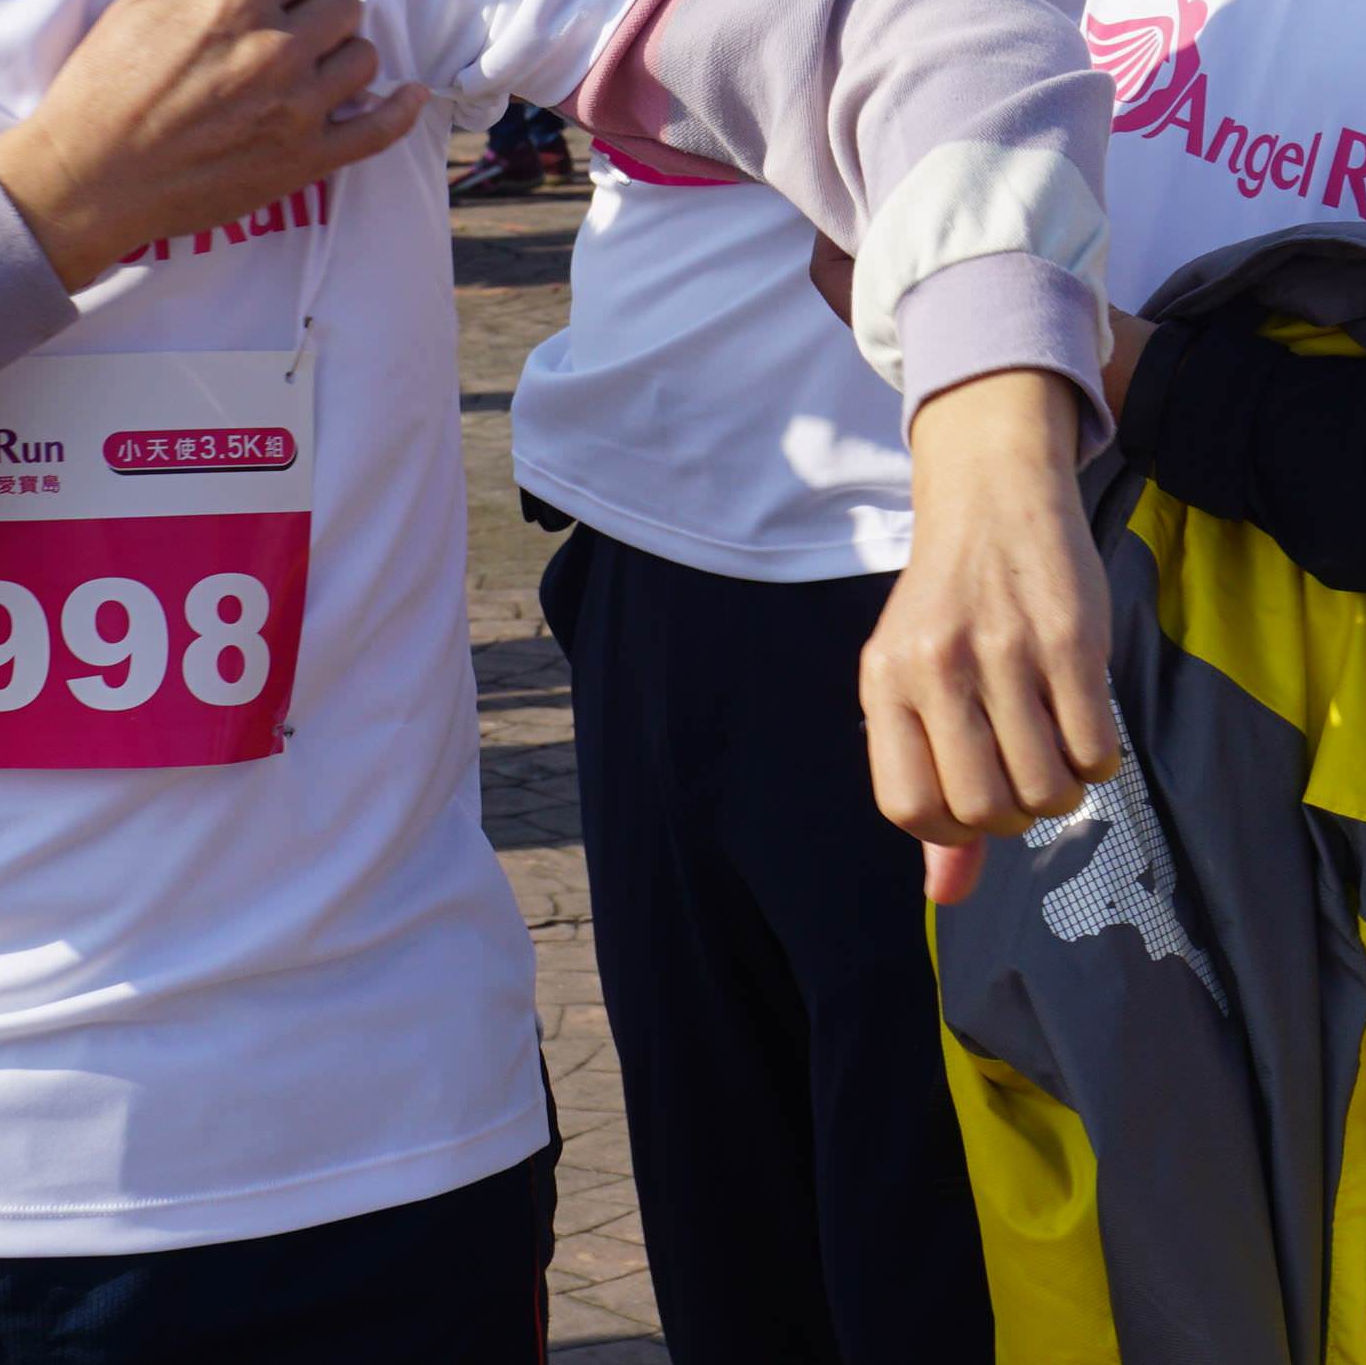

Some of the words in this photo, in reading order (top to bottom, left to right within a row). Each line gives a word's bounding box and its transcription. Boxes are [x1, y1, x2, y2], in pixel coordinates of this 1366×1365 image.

[1141, 72, 1323, 199] Angel
[117, 434, 285, 463] 小天使3.5K組
